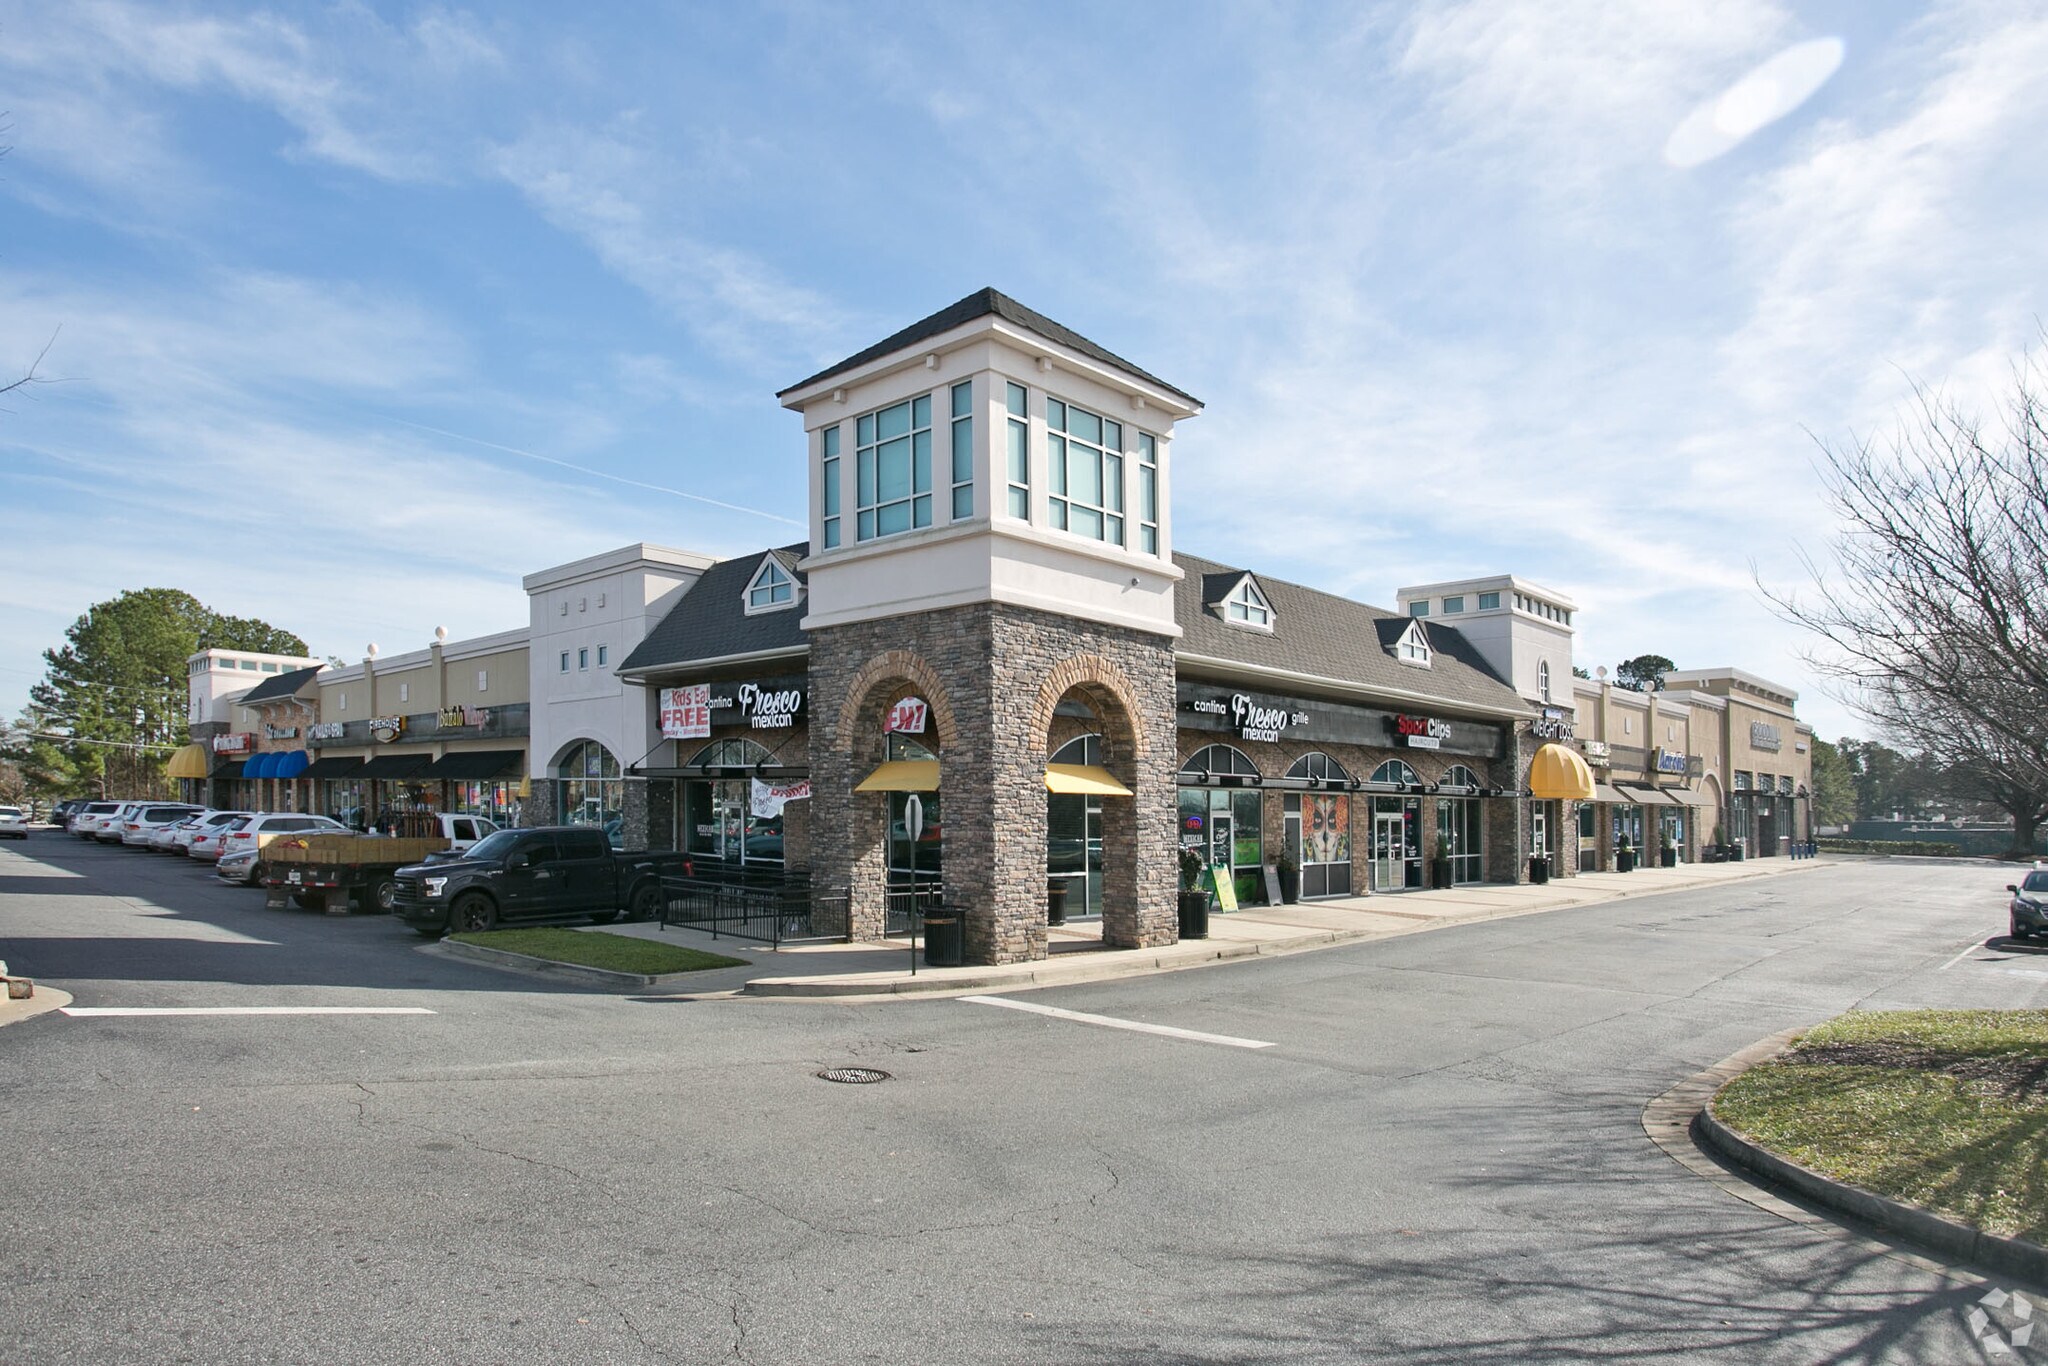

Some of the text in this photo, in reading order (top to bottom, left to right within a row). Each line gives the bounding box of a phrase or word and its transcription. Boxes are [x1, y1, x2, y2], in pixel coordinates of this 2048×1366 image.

[672, 688, 692, 706] Kids
[694, 686, 709, 704] Eat
[705, 683, 801, 716] cantina Fresco
[661, 706, 709, 727] FREE
[752, 712, 792, 729] mexican
[1194, 693, 1309, 730] cantina Fresco grille
[369, 717, 400, 732] FIREHOUSE
[1243, 727, 1278, 742] mexican
[1398, 713, 1451, 740] Sport Clips
[1533, 719, 1574, 741] WEIGHT LOSS
